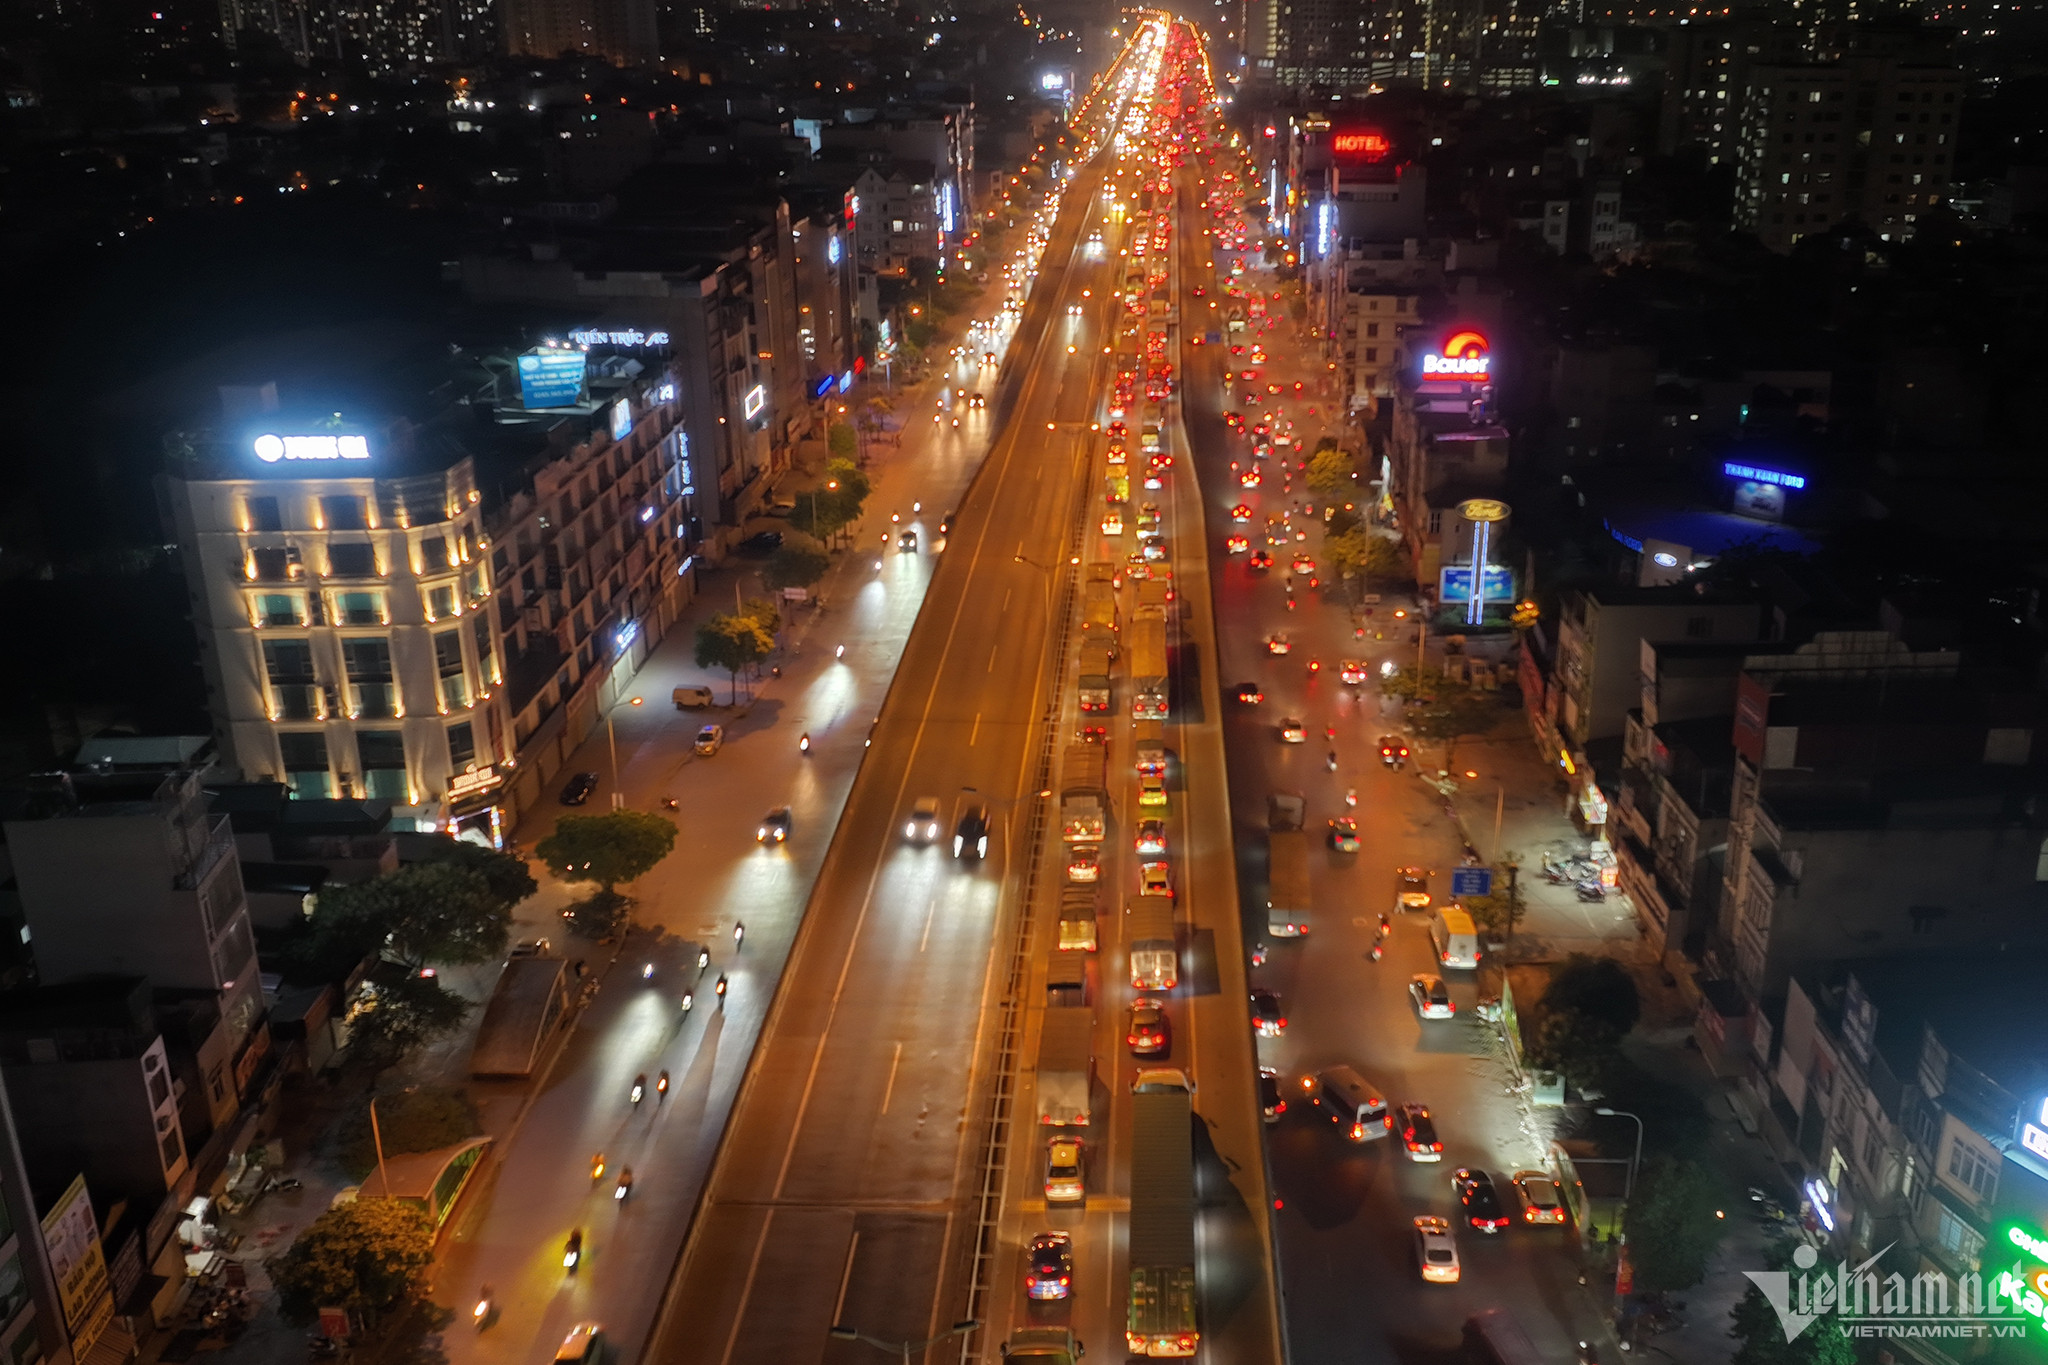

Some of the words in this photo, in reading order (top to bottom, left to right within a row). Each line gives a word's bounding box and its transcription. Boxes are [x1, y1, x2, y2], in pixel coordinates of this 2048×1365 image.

[1335, 135, 1387, 151] HOTEL
[609, 328, 645, 347] TRÚC
[645, 332, 669, 347] AC
[1465, 501, 1502, 518] Ford
